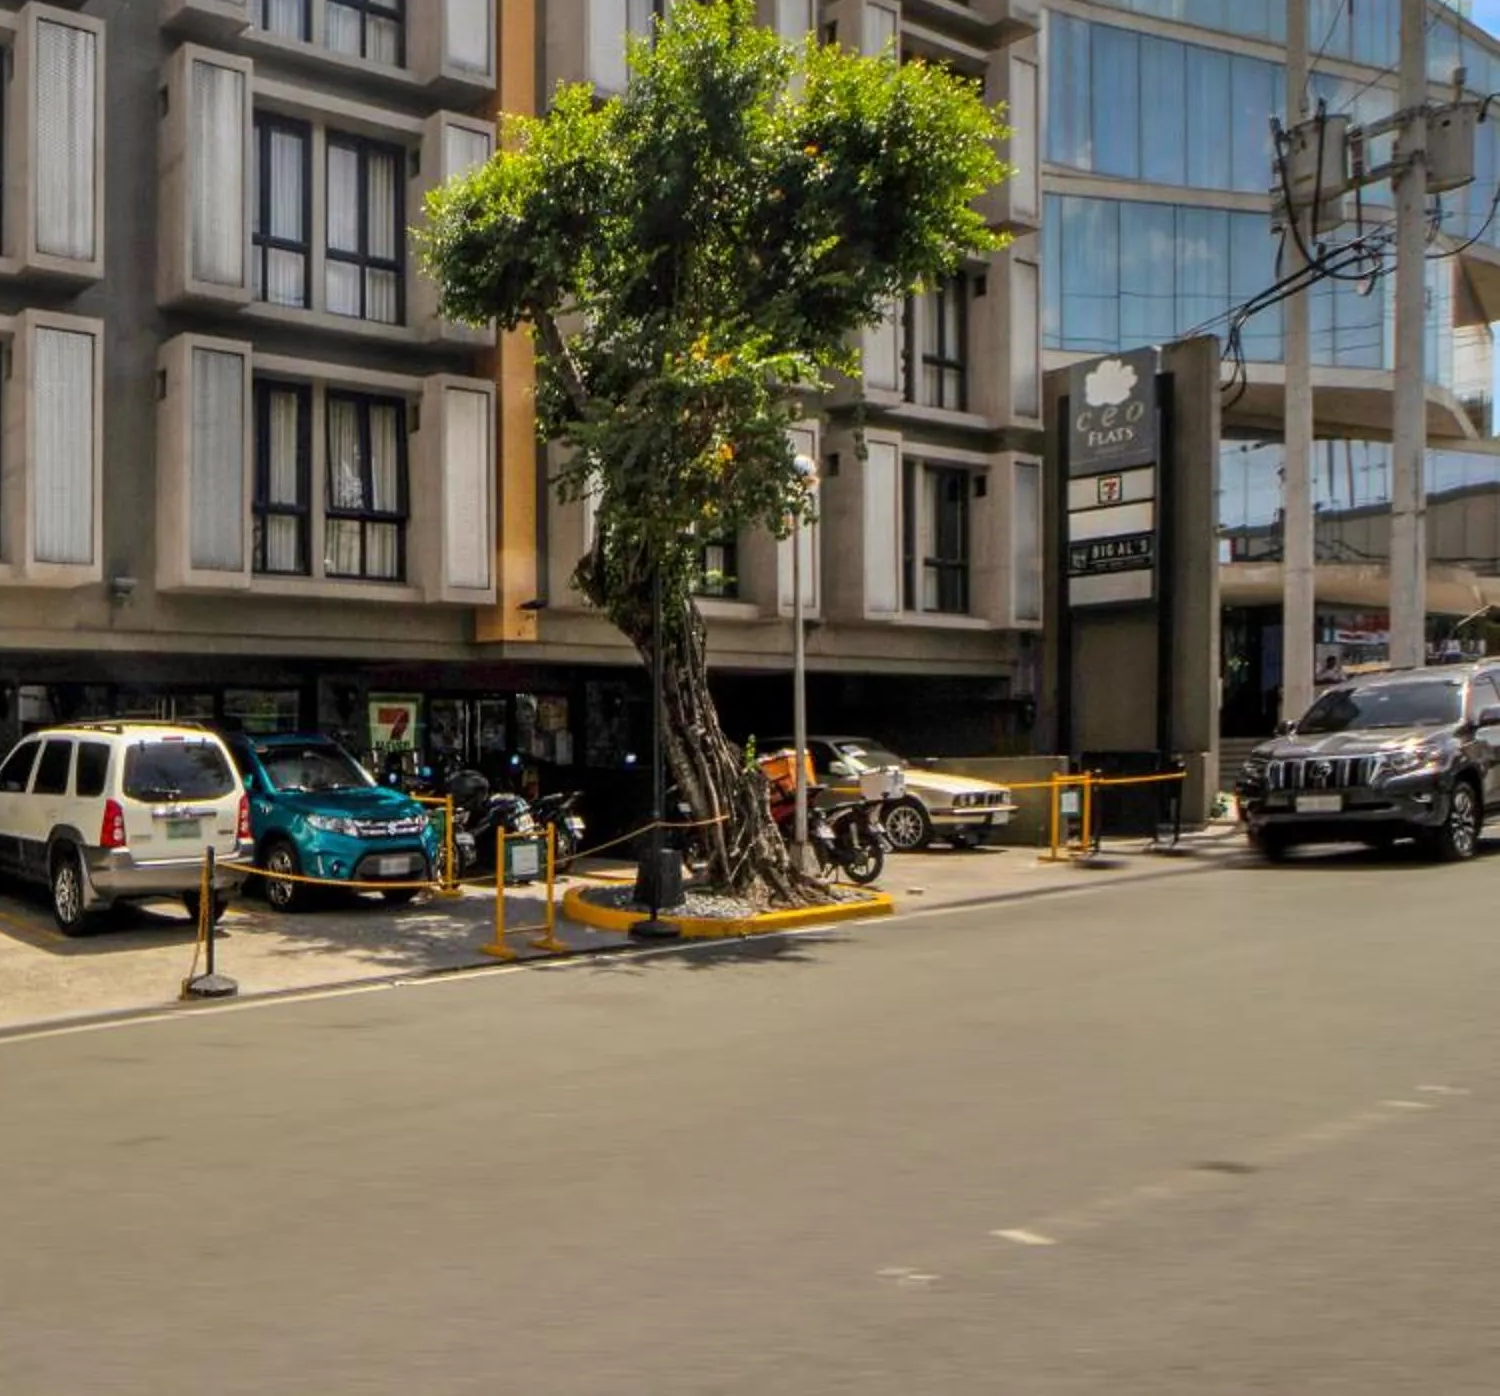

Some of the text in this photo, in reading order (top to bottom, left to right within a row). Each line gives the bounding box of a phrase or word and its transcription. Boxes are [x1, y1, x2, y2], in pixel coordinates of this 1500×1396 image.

[1087, 426, 1135, 447] FLATS
[1118, 539, 1148, 556] ALS
[377, 707, 410, 741] 7
